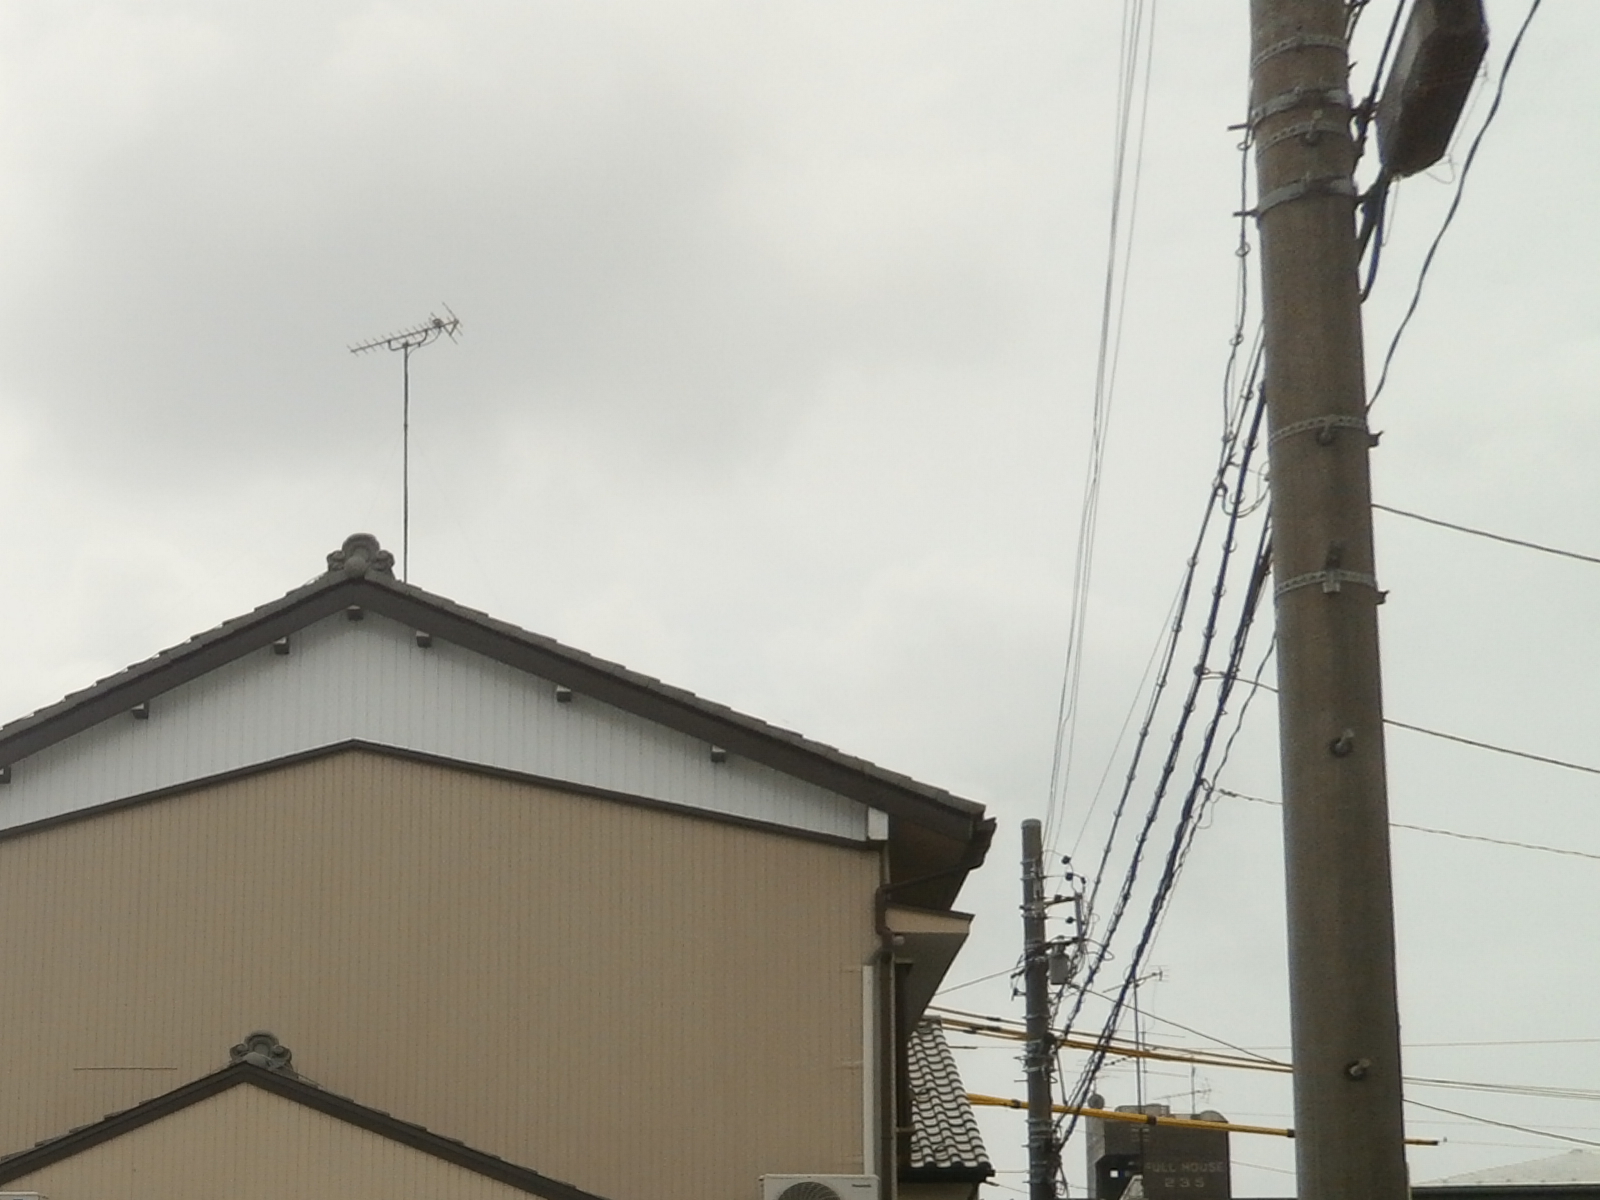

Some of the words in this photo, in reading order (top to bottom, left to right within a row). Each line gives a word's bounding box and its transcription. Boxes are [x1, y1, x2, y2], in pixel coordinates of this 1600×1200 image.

[1144, 1161, 1176, 1173] FULL
[1181, 1161, 1225, 1173] HOUSE
[1164, 1177, 1205, 1188] 235
